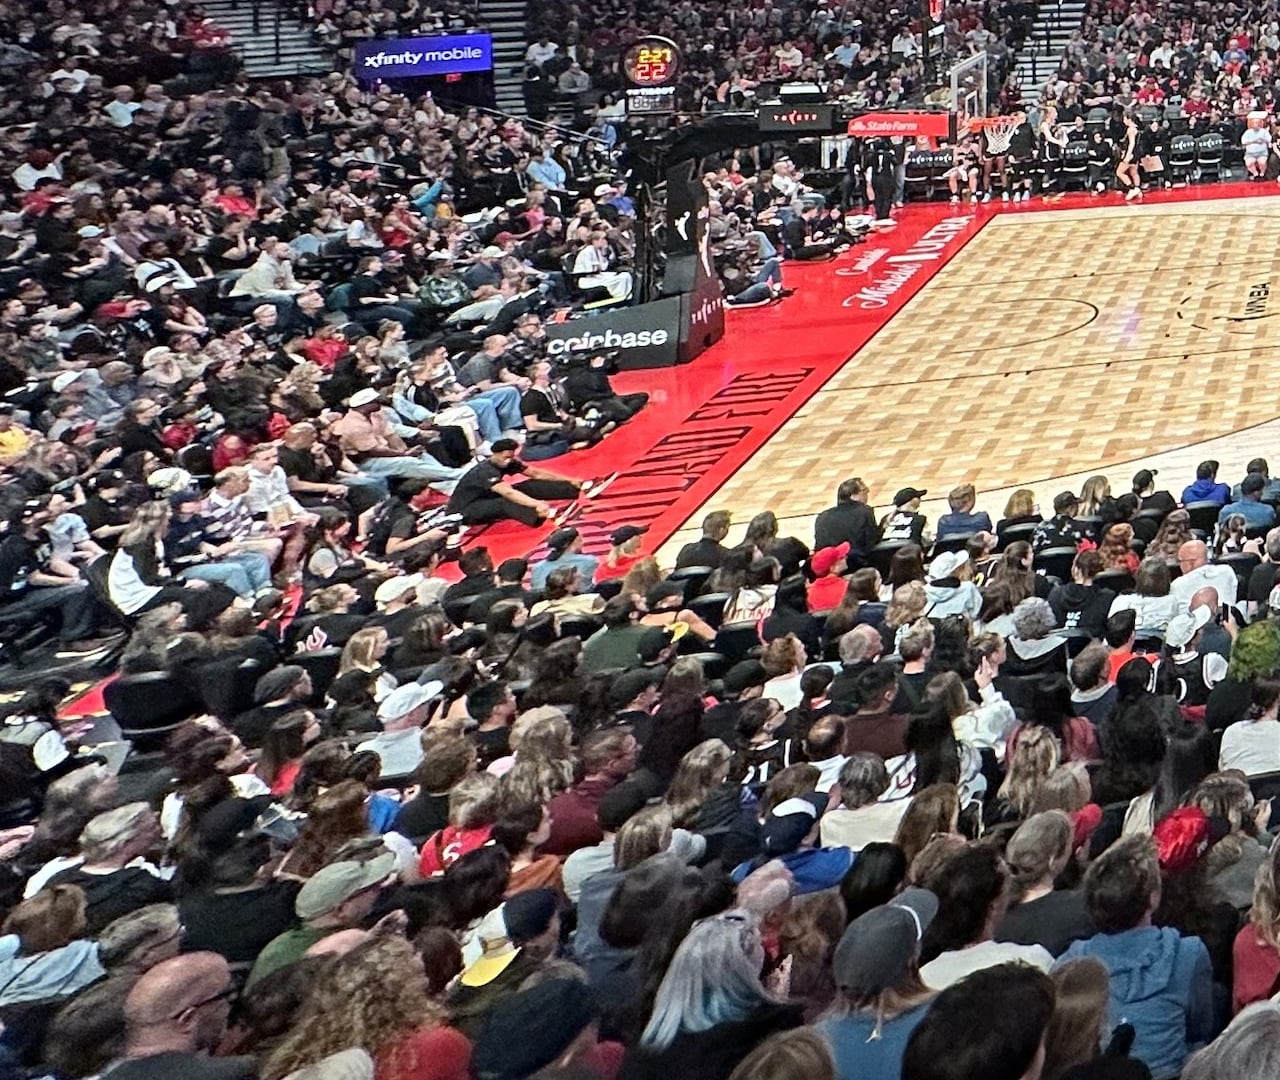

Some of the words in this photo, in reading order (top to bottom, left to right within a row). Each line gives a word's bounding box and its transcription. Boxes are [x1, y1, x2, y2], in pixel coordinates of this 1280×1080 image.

[366, 51, 423, 68] xfinity
[426, 46, 483, 61] mobile
[636, 64, 666, 81] 22
[1244, 281, 1270, 316] WNBA
[547, 328, 668, 356] coinbase
[683, 367, 816, 426] FIRE
